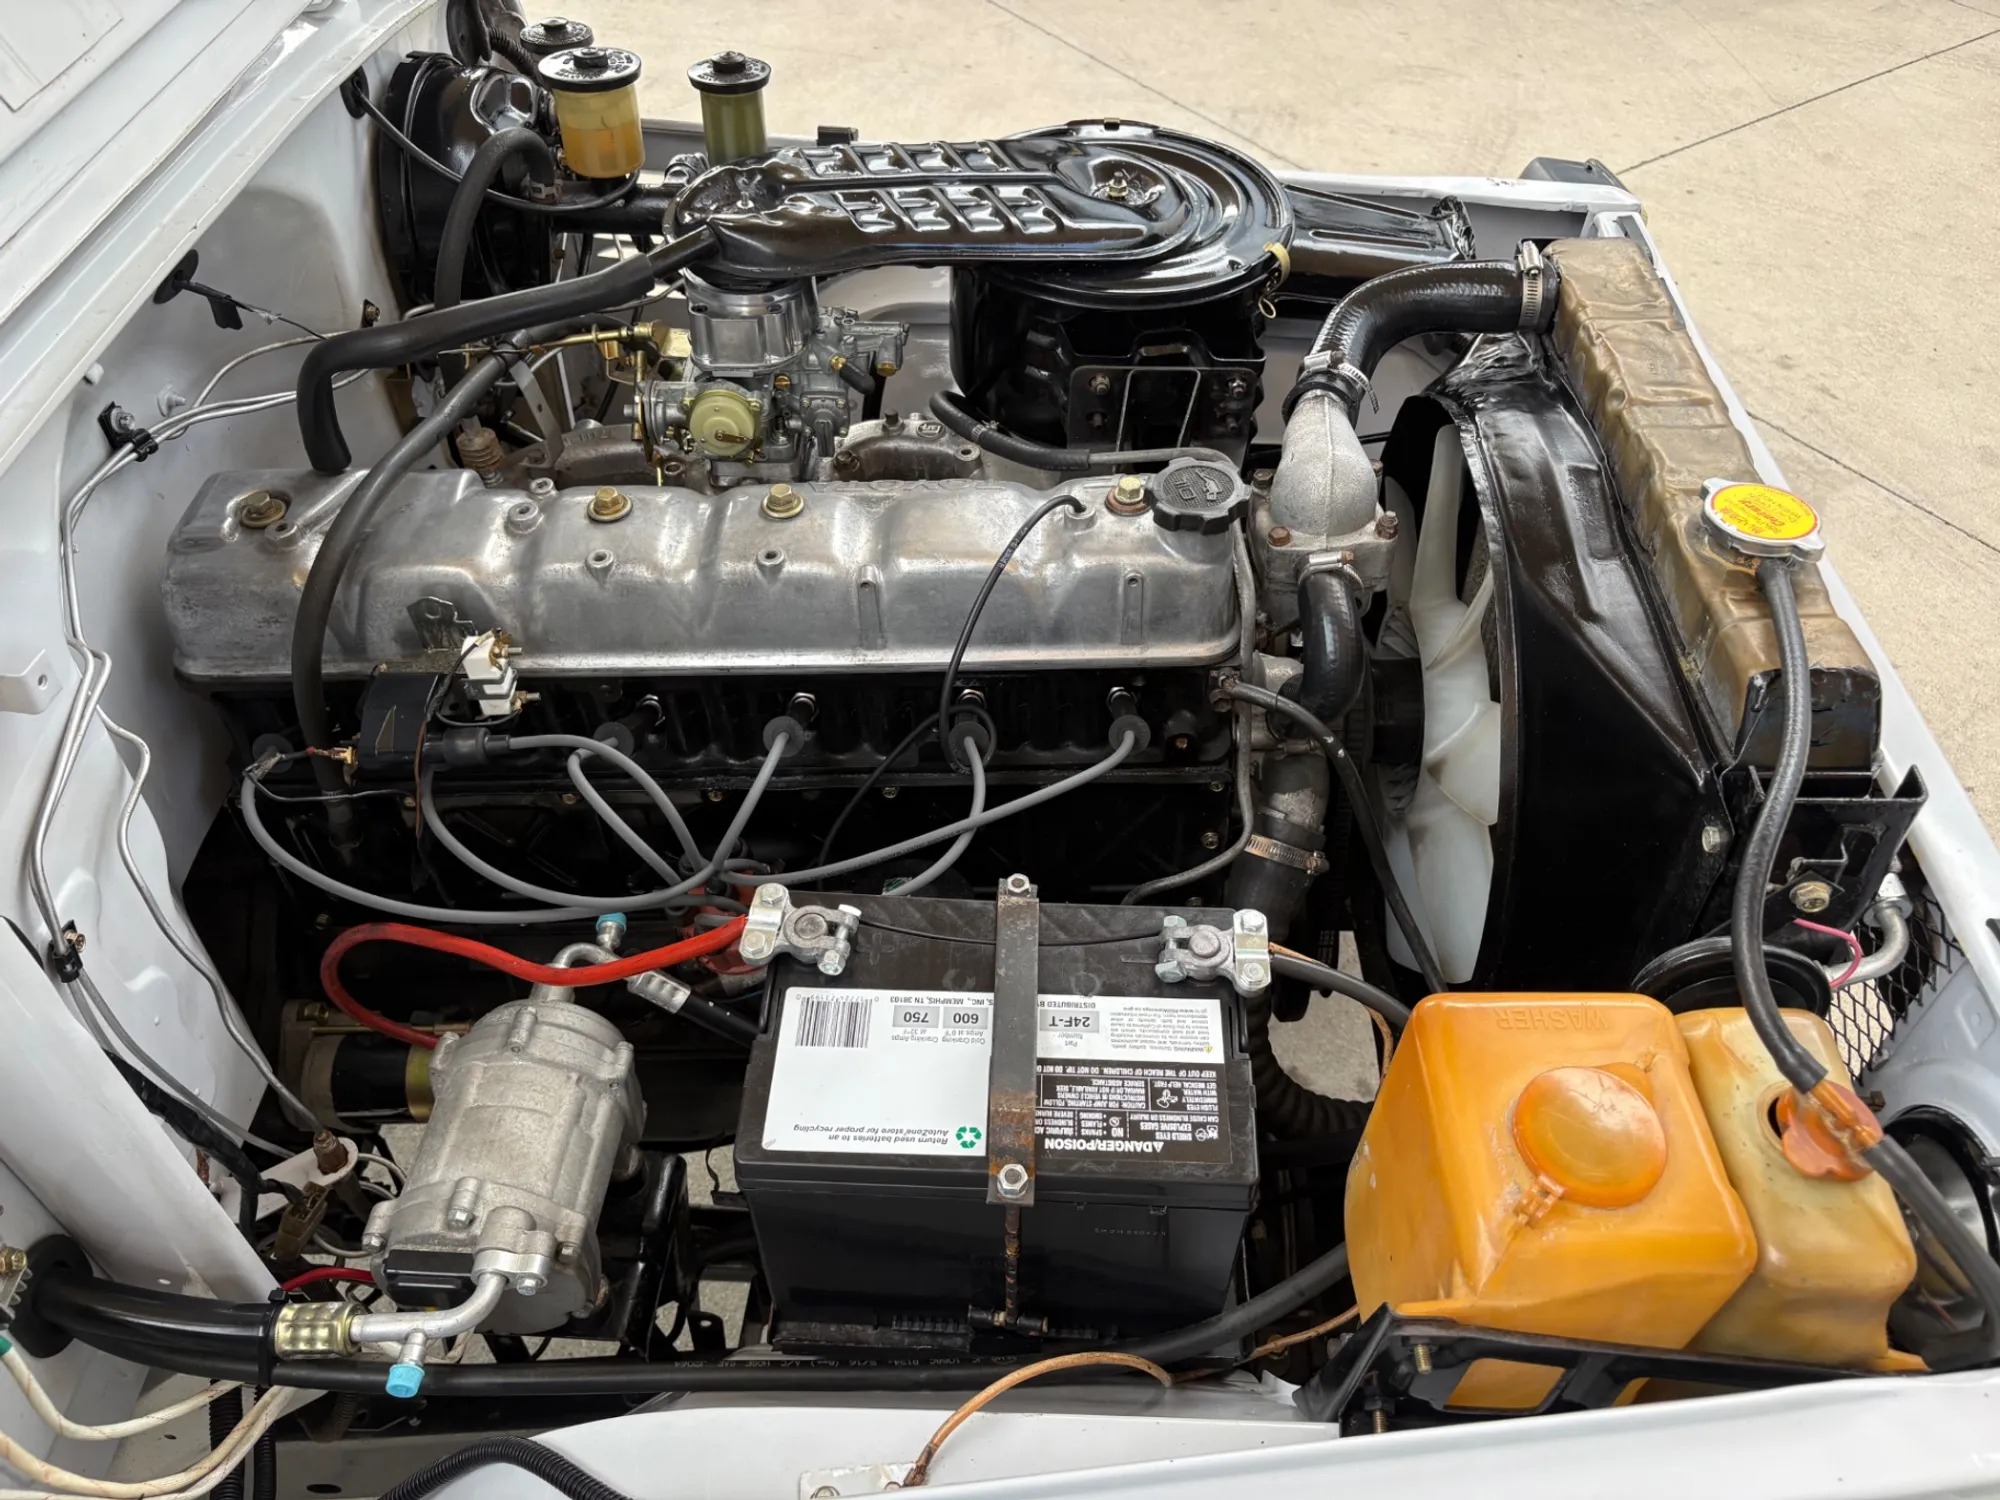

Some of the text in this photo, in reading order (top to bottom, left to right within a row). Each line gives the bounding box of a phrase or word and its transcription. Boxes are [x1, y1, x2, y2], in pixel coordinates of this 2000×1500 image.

[914, 996, 924, 1004] TN
[926, 996, 964, 1005] MEMPHIS,
[1047, 1000, 1096, 1009] DISTRIBUTED
[903, 1010, 930, 1023] 750
[952, 1012, 979, 1024] 600
[1493, 1009, 1609, 1031] WASHER
[1048, 1016, 1090, 1028] 24F-T
[1178, 1070, 1186, 1078] OF
[1188, 1070, 1200, 1078] OUT
[1200, 1070, 1216, 1078] KEEP
[792, 1124, 834, 1133] recycling
[834, 1126, 865, 1134] proper
[866, 1126, 879, 1135] for
[881, 1127, 904, 1136] store
[1034, 1126, 1044, 1134] ACI
[1111, 1128, 1124, 1138] NO
[842, 1134, 850, 1142] to
[852, 1134, 892, 1144] batteries
[894, 1136, 916, 1144] used
[918, 1136, 948, 1145] Return
[1044, 1138, 1152, 1152] DANGER/POISON
